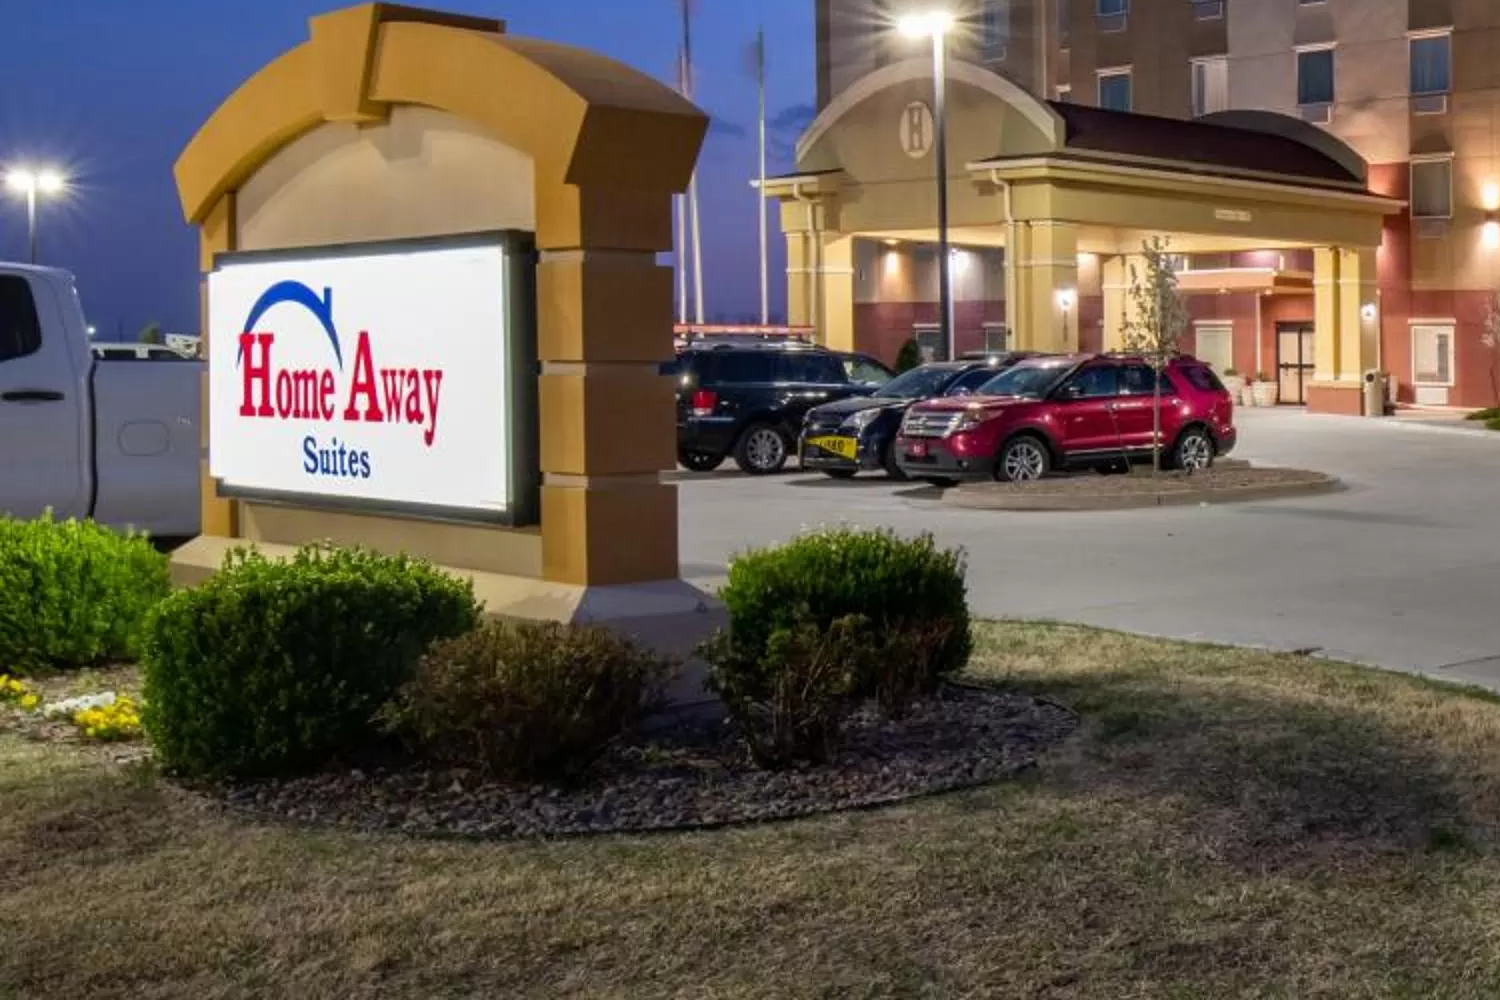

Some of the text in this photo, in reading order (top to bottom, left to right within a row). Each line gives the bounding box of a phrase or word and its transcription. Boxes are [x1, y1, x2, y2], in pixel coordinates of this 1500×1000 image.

[239, 330, 443, 447] Home Away
[303, 436, 371, 479] Suites
